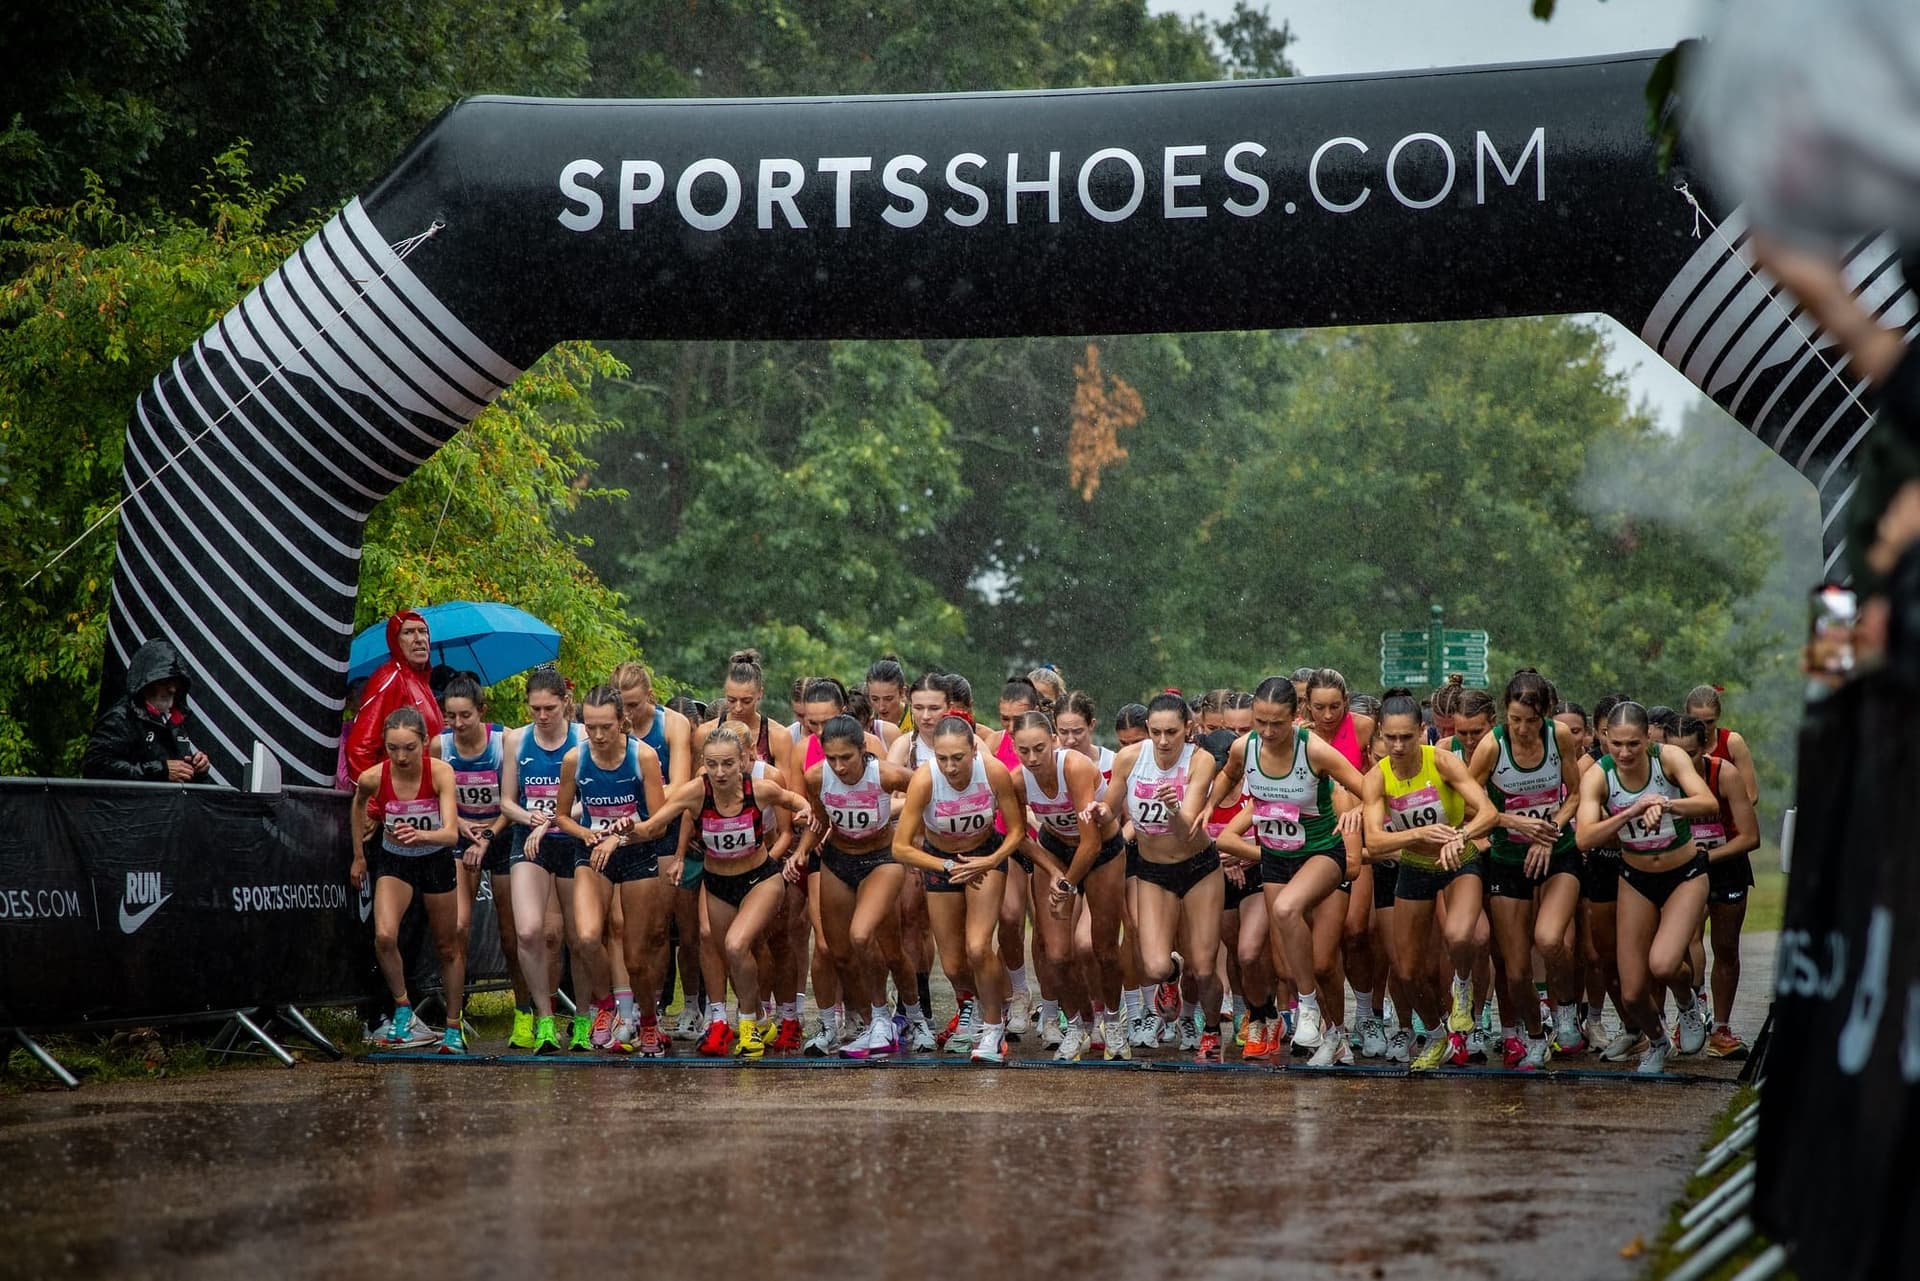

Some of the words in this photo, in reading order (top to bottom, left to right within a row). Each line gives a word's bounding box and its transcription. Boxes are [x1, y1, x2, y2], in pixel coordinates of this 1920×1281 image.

[557, 126, 1547, 232] SPORTSSHOES.COM
[459, 787, 493, 804] 198
[585, 794, 635, 806] SCOTLAND
[832, 810, 870, 829] 219
[950, 814, 985, 833] 170
[1400, 806, 1438, 830] 169
[713, 832, 747, 851] 184
[126, 871, 162, 904] RUN
[232, 883, 348, 912] SPORTSSHOES.COM
[0, 889, 81, 918] OES.COM
